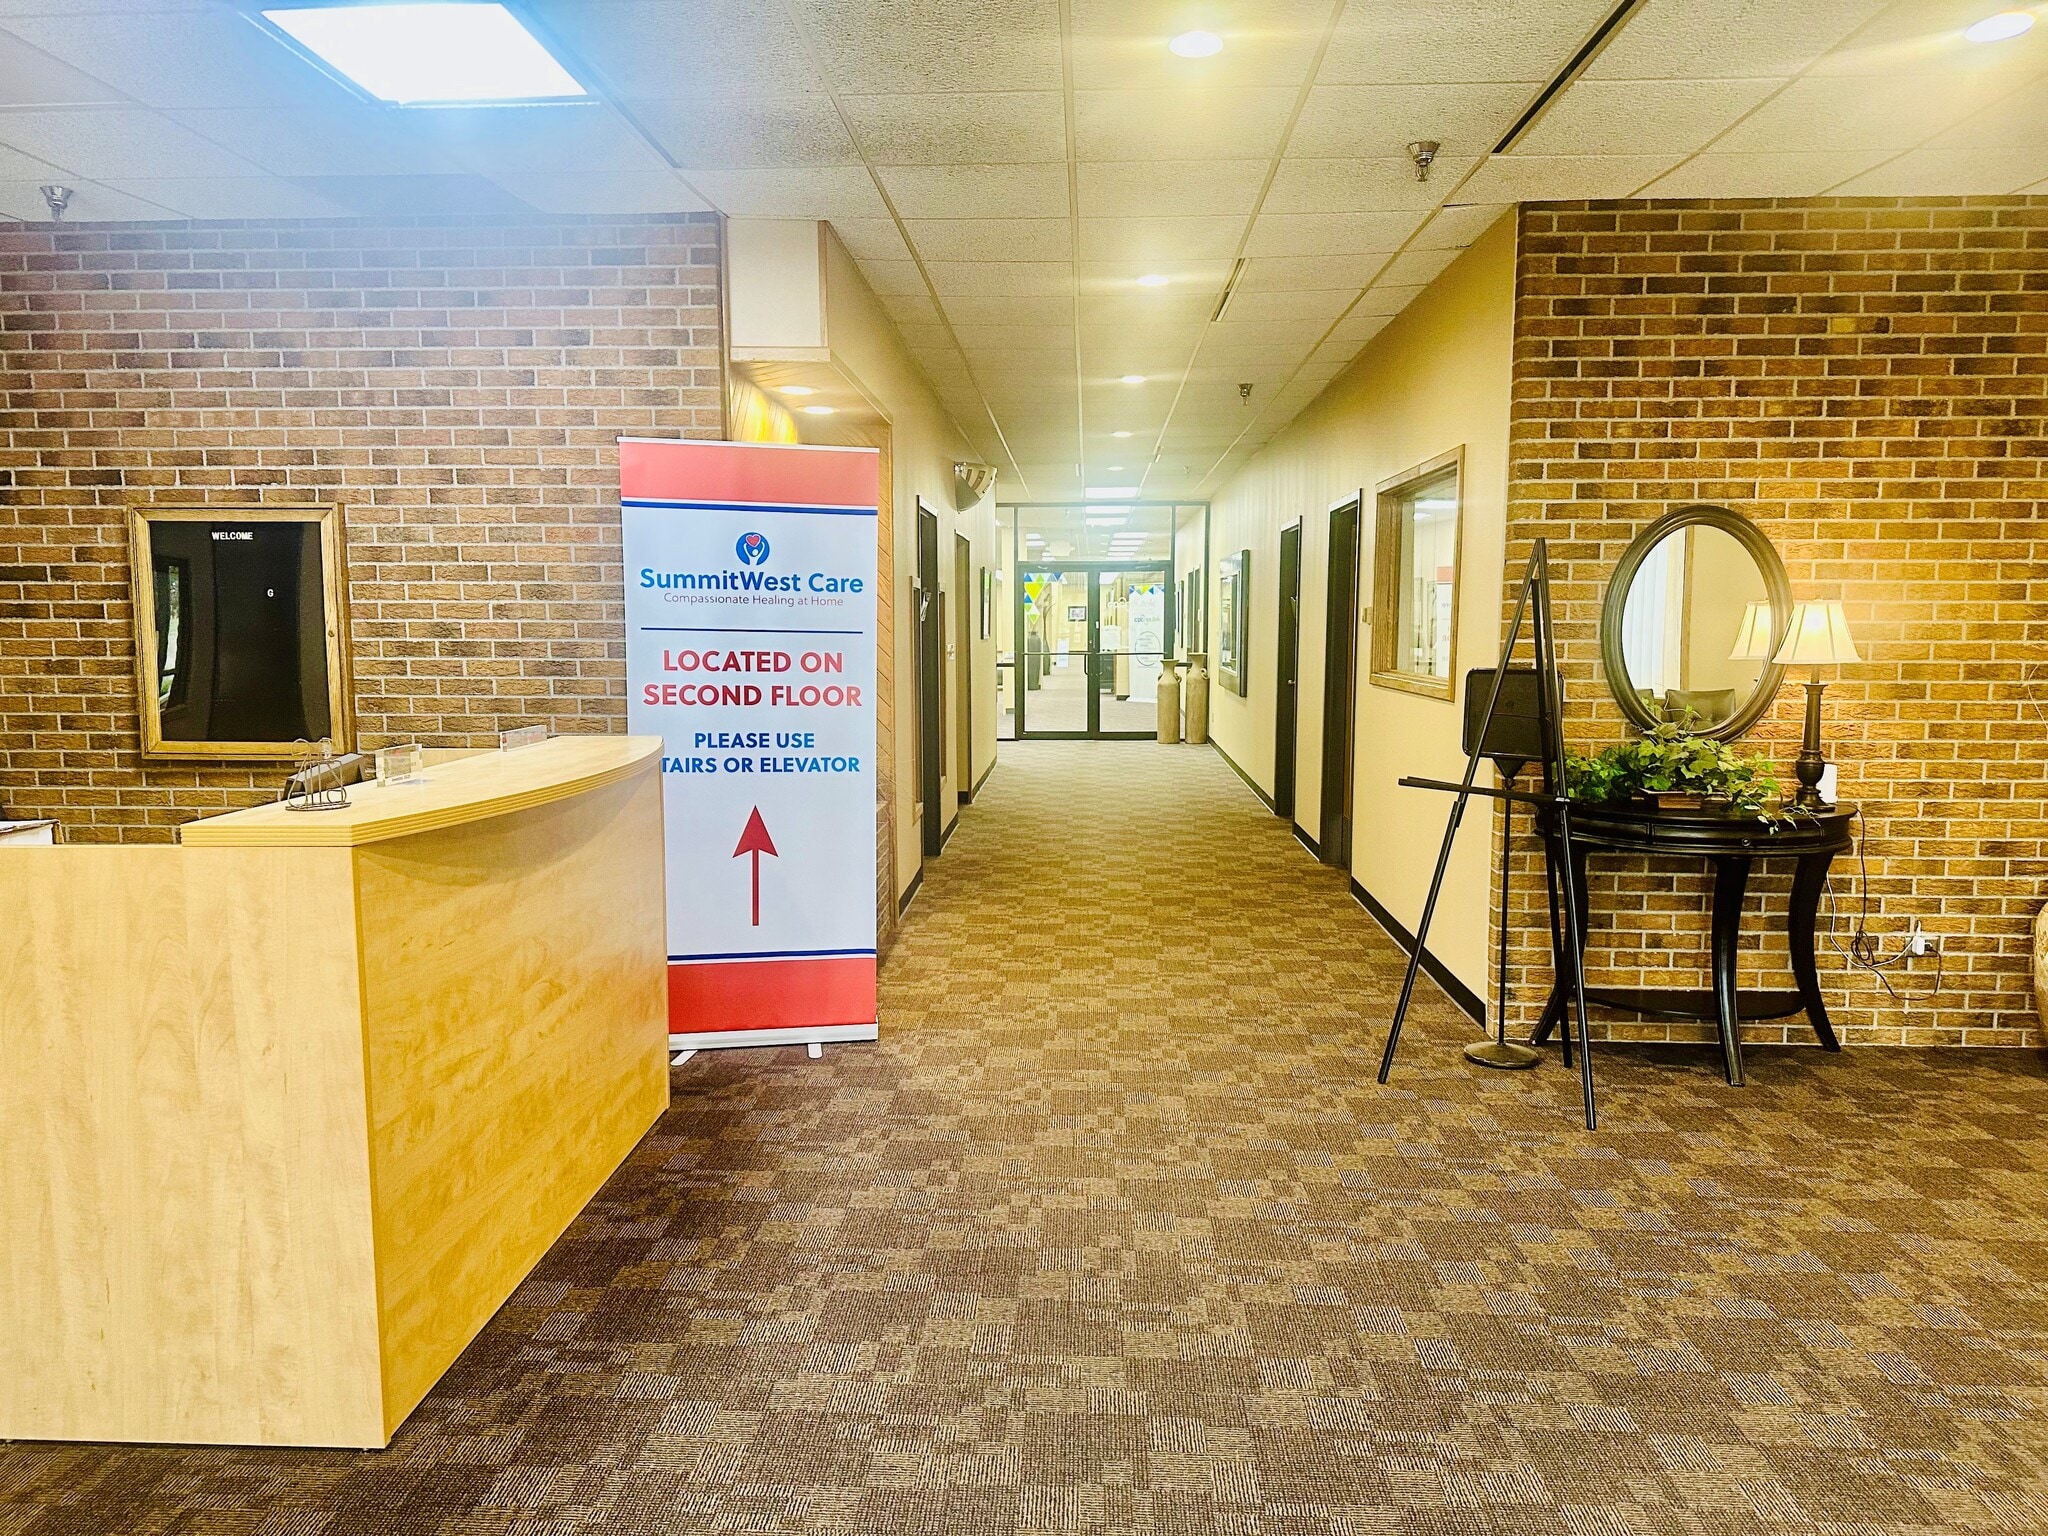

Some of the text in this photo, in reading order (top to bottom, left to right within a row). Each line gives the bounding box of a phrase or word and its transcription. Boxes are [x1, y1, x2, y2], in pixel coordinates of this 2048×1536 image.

[211, 531, 254, 541] WELCOME
[639, 568, 864, 594] SummitWest Care
[266, 588, 274, 598] G
[663, 592, 844, 608] Compassionate Healing at Home
[663, 649, 843, 673] LOCATED ON
[643, 683, 862, 707] SECOND FLOOR
[694, 732, 815, 749] PLEASE USE
[660, 756, 860, 773] TAIRS OR ELEVATOR
